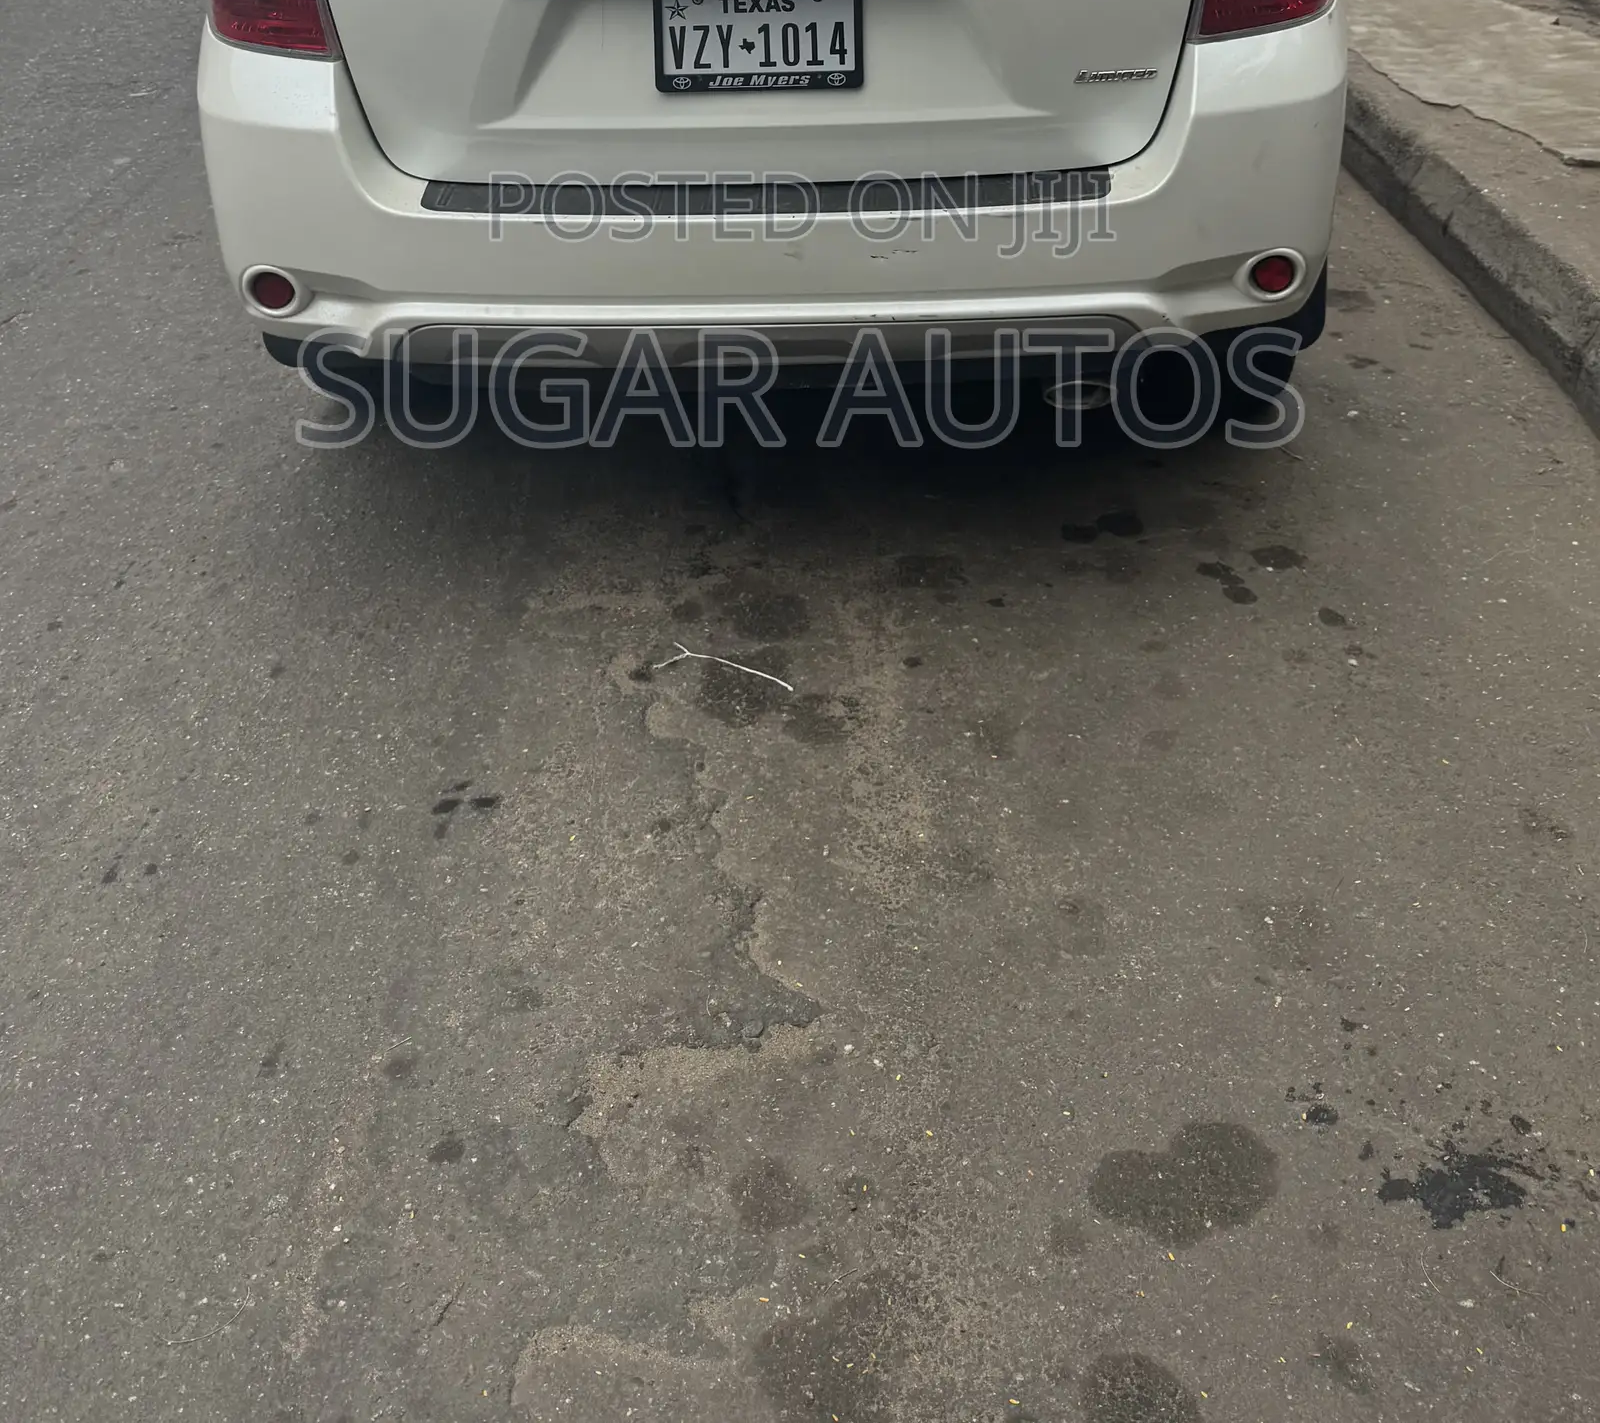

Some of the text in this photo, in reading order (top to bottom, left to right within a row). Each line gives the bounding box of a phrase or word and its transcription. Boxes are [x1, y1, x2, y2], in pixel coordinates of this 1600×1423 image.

[668, 21, 848, 70] VZY 1014
[709, 73, 811, 89] Joe Myers
